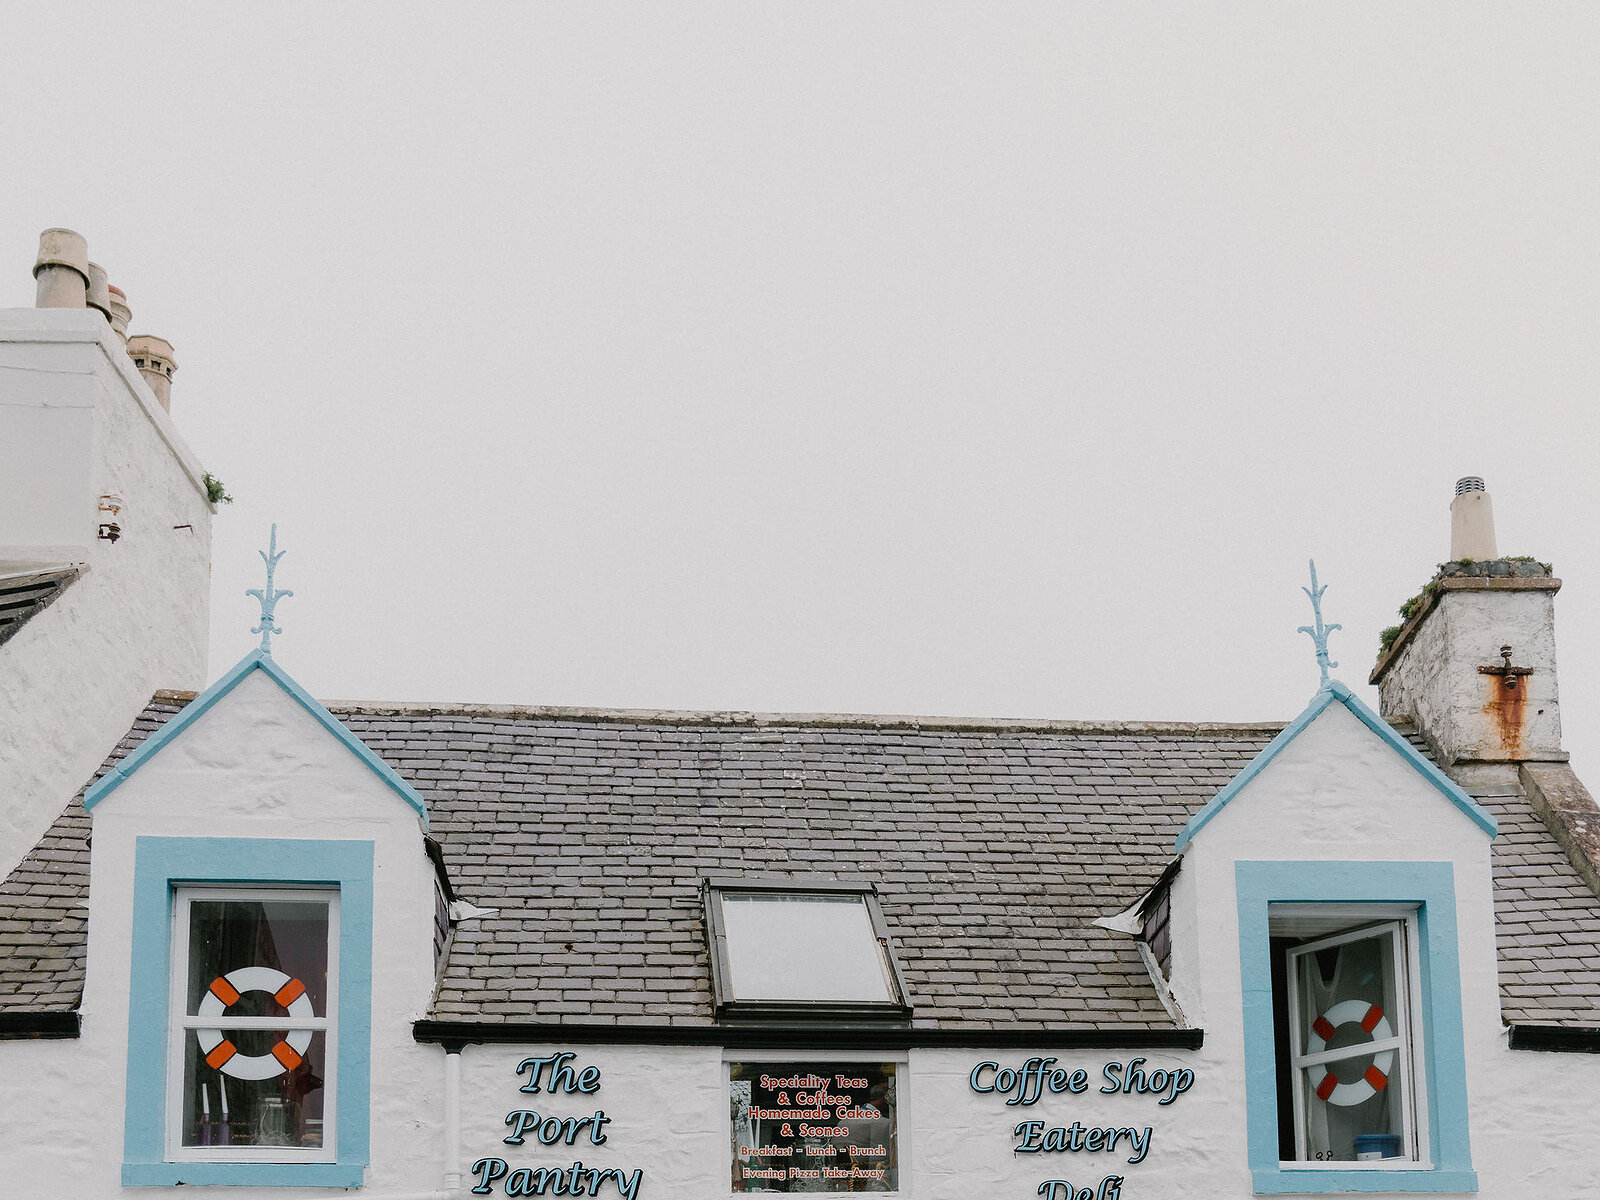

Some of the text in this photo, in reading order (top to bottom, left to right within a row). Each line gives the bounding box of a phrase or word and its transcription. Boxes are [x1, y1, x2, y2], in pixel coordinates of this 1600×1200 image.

[516, 1052, 601, 1094] The
[969, 1057, 1195, 1105] Coffee Shop
[760, 1073, 868, 1091] Speciality Teas
[777, 1091, 851, 1105] & Coffees
[748, 1105, 880, 1119] Homemade Cakes
[503, 1110, 612, 1146] Port
[780, 1122, 849, 1137] & Scones
[1013, 1121, 1153, 1164] Eatery
[741, 1145, 793, 1157] Breakfast
[806, 1145, 836, 1156] Lunch
[850, 1145, 886, 1156] Brunch
[743, 1167, 885, 1181] Evening Pizza Take-Away
